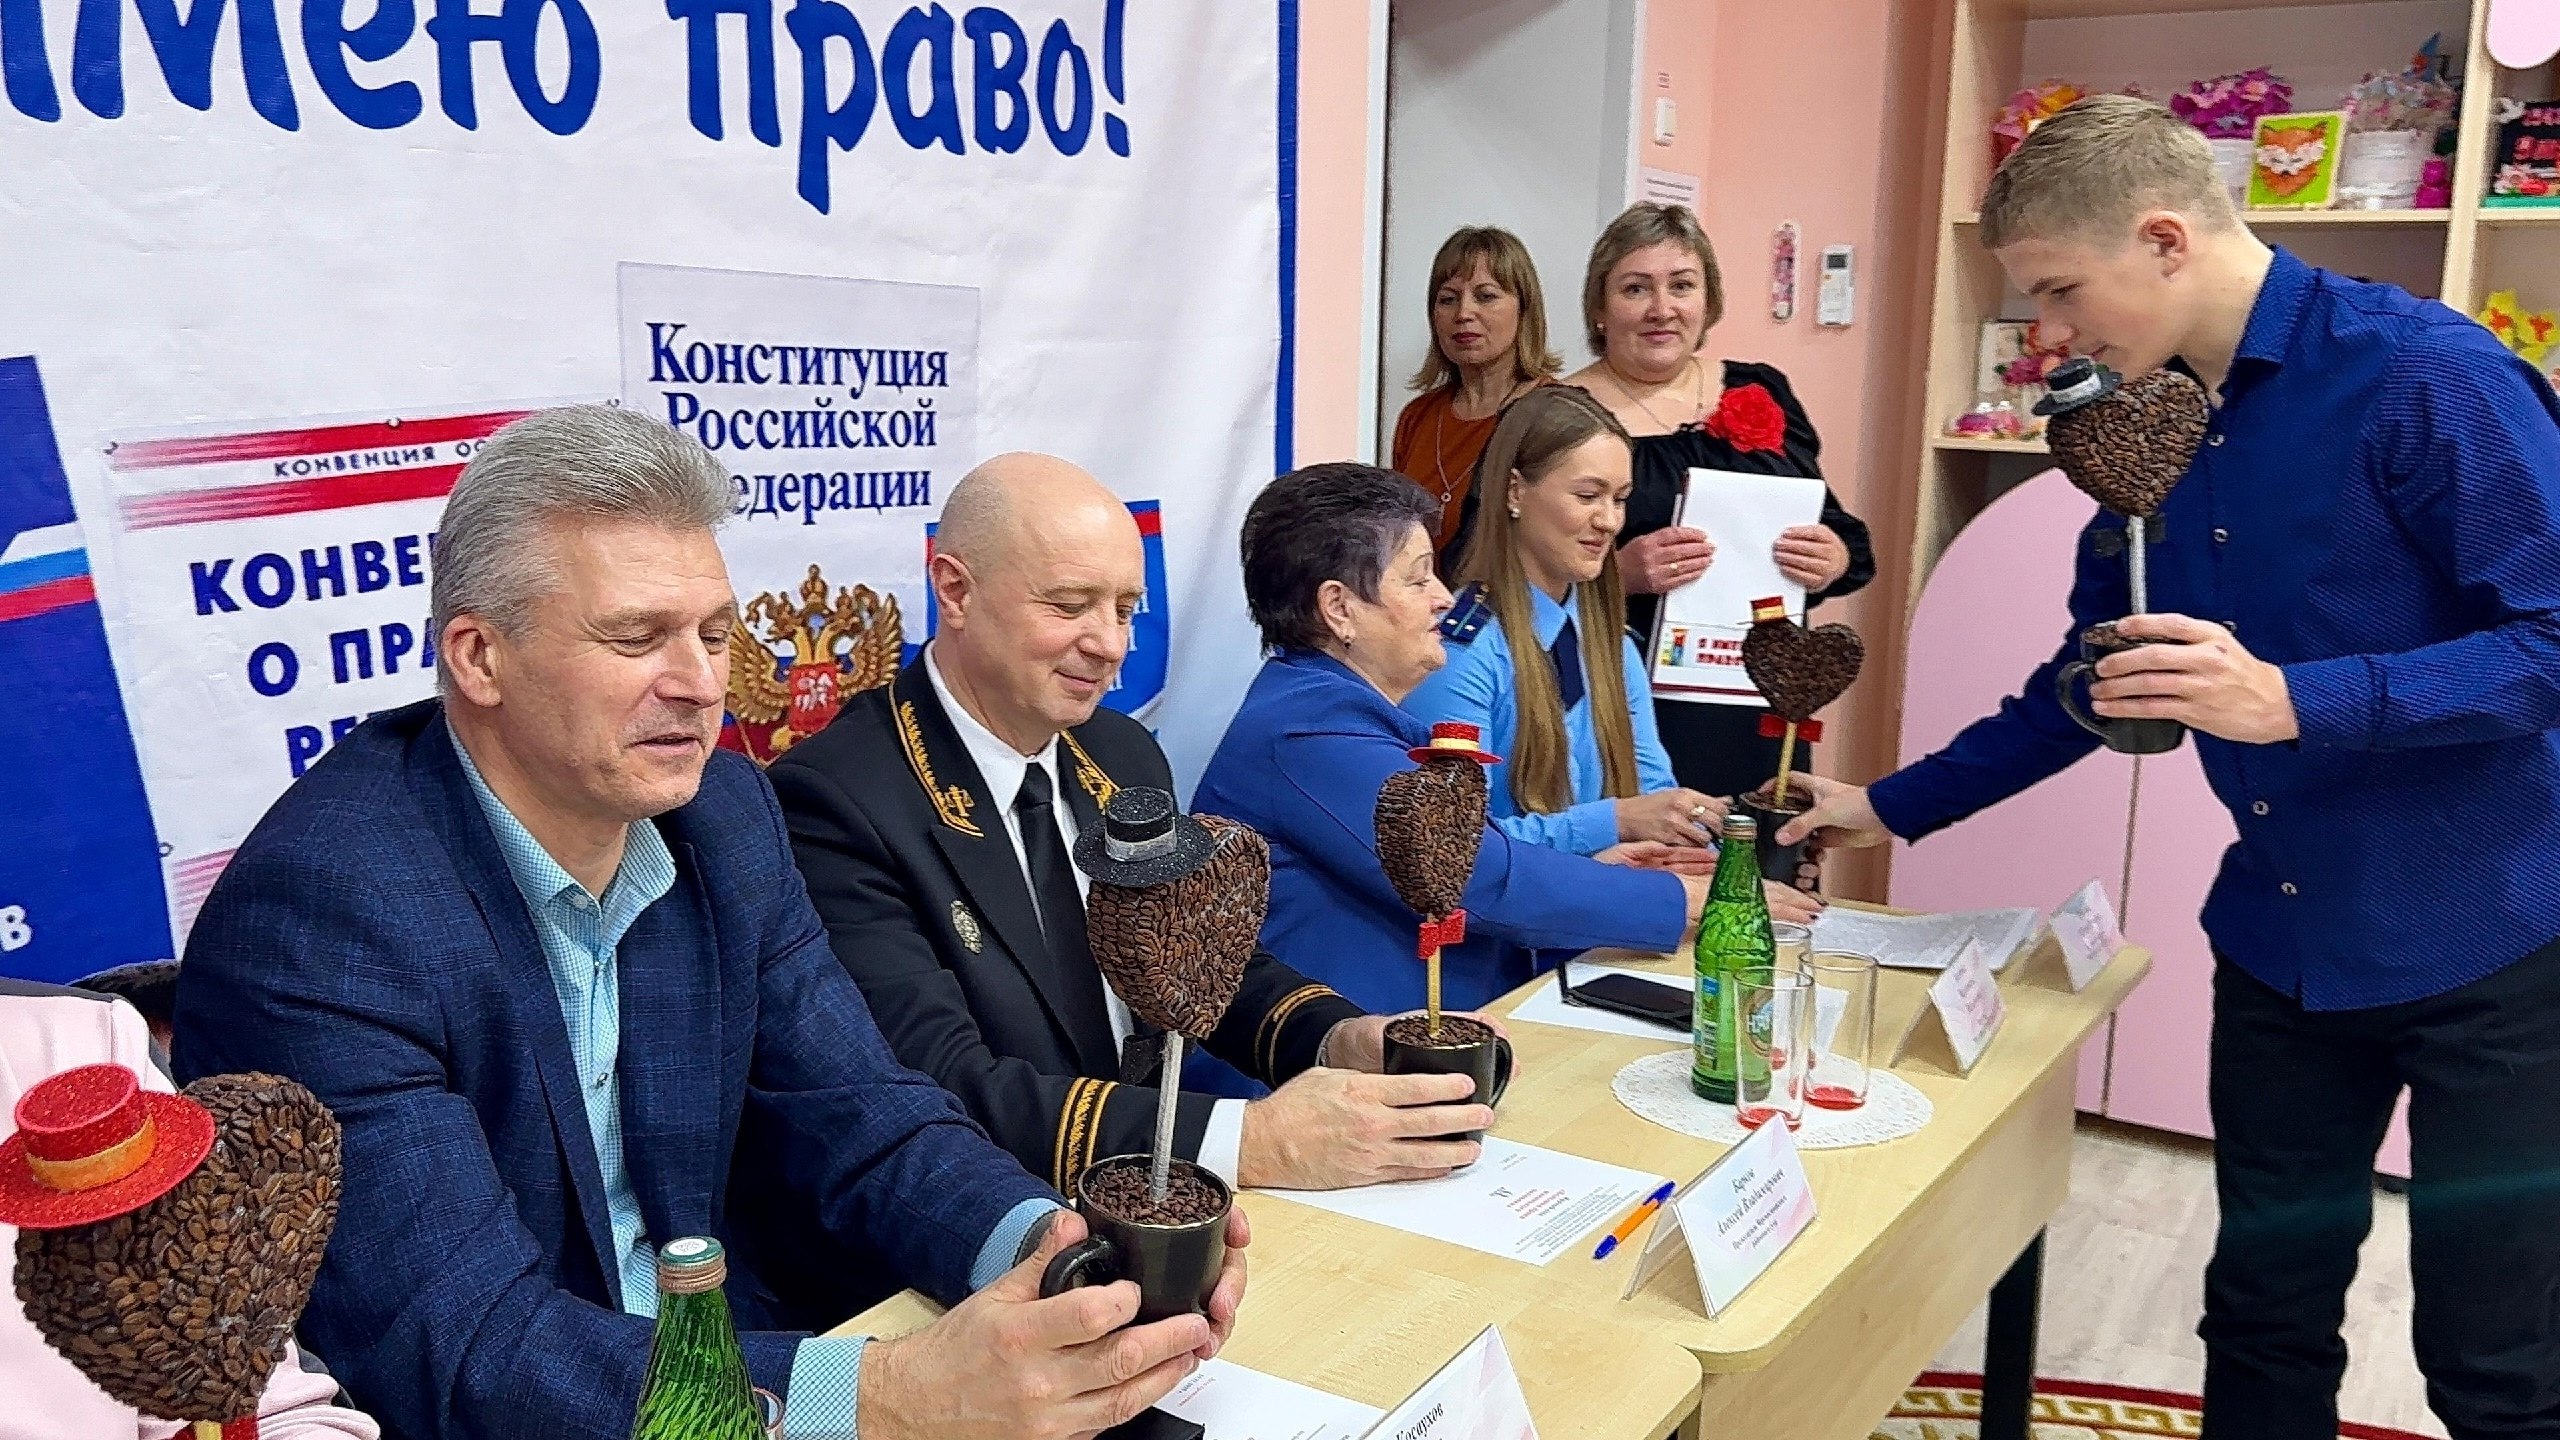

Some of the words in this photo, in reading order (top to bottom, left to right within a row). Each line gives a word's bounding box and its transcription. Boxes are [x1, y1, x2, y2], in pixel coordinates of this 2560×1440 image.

[665, 0, 1131, 215] право!
[646, 321, 949, 399] Конституция
[662, 391, 938, 450] Российской
[274, 446, 436, 477] КОНВЕНЦИЯ
[730, 470, 932, 525] едерации
[189, 534, 440, 615] КОНВЕ
[247, 641, 299, 697] О
